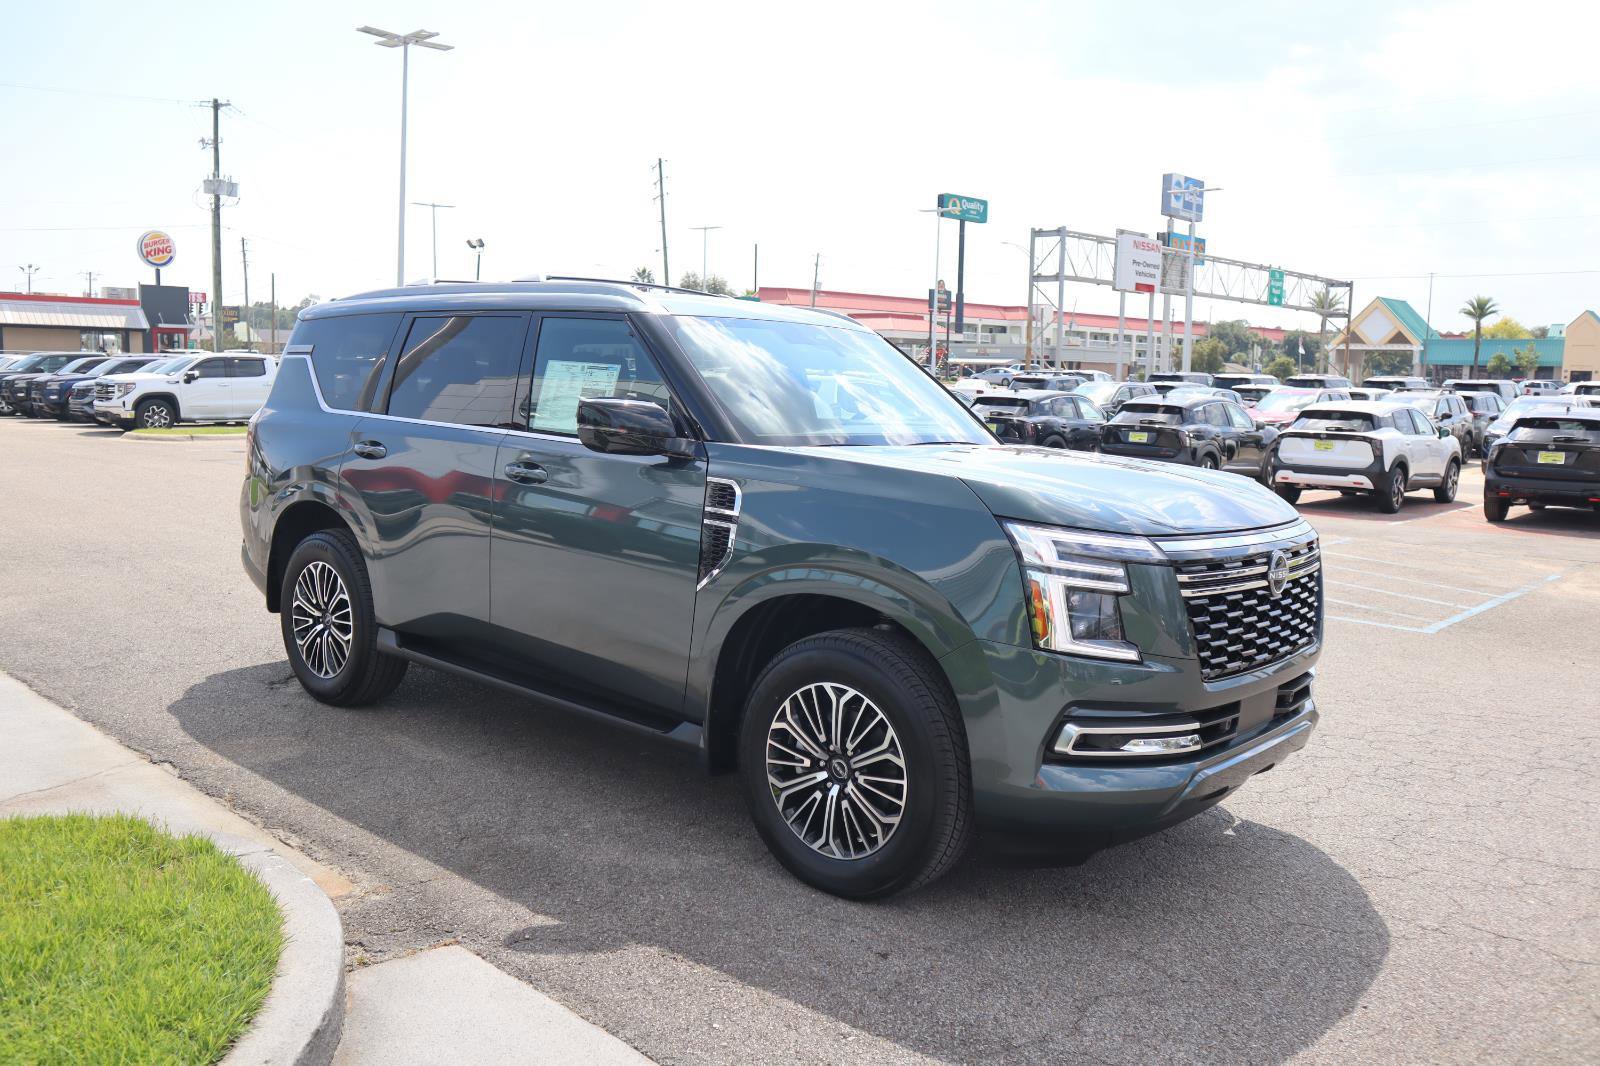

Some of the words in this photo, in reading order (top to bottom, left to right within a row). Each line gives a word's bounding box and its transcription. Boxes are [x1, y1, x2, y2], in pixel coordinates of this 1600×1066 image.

[962, 199, 984, 213] Quality
[144, 239, 171, 249] BURGER
[1133, 240, 1161, 253] NISSAN
[144, 246, 172, 258] KING
[1132, 259, 1160, 270] Pre-Owned
[1135, 269, 1156, 279] Vehicles
